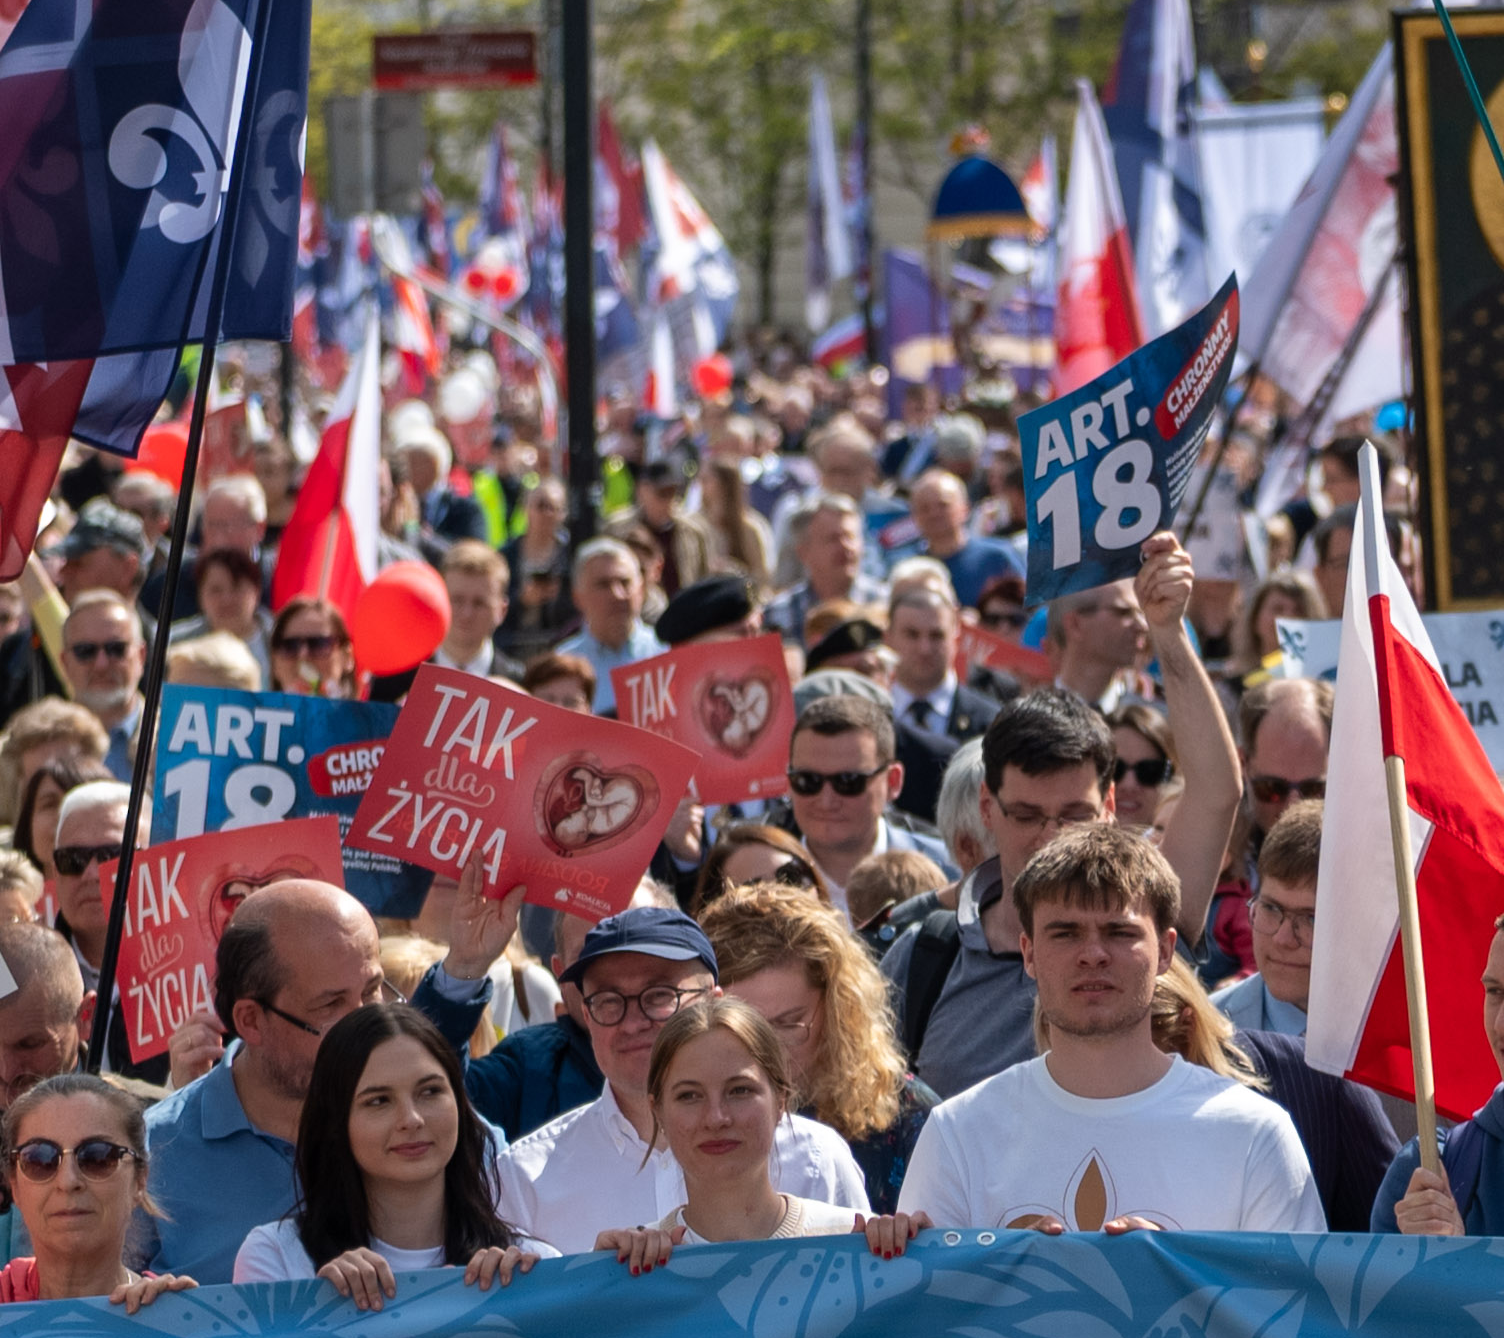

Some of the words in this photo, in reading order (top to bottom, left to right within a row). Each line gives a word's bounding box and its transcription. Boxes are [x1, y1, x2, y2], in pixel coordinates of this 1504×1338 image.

[1034, 378, 1151, 480] ART.
[1036, 439, 1161, 571] 18
[167, 702, 305, 765] ART.
[423, 684, 538, 780] TAK
[626, 664, 677, 727] TAK
[164, 759, 296, 841] 18
[326, 746, 385, 776] CHRO
[423, 752, 495, 808] dla
[367, 781, 507, 885] ŻYCIA
[140, 932, 184, 982] dla
[129, 963, 215, 1046] ŻYCIA
